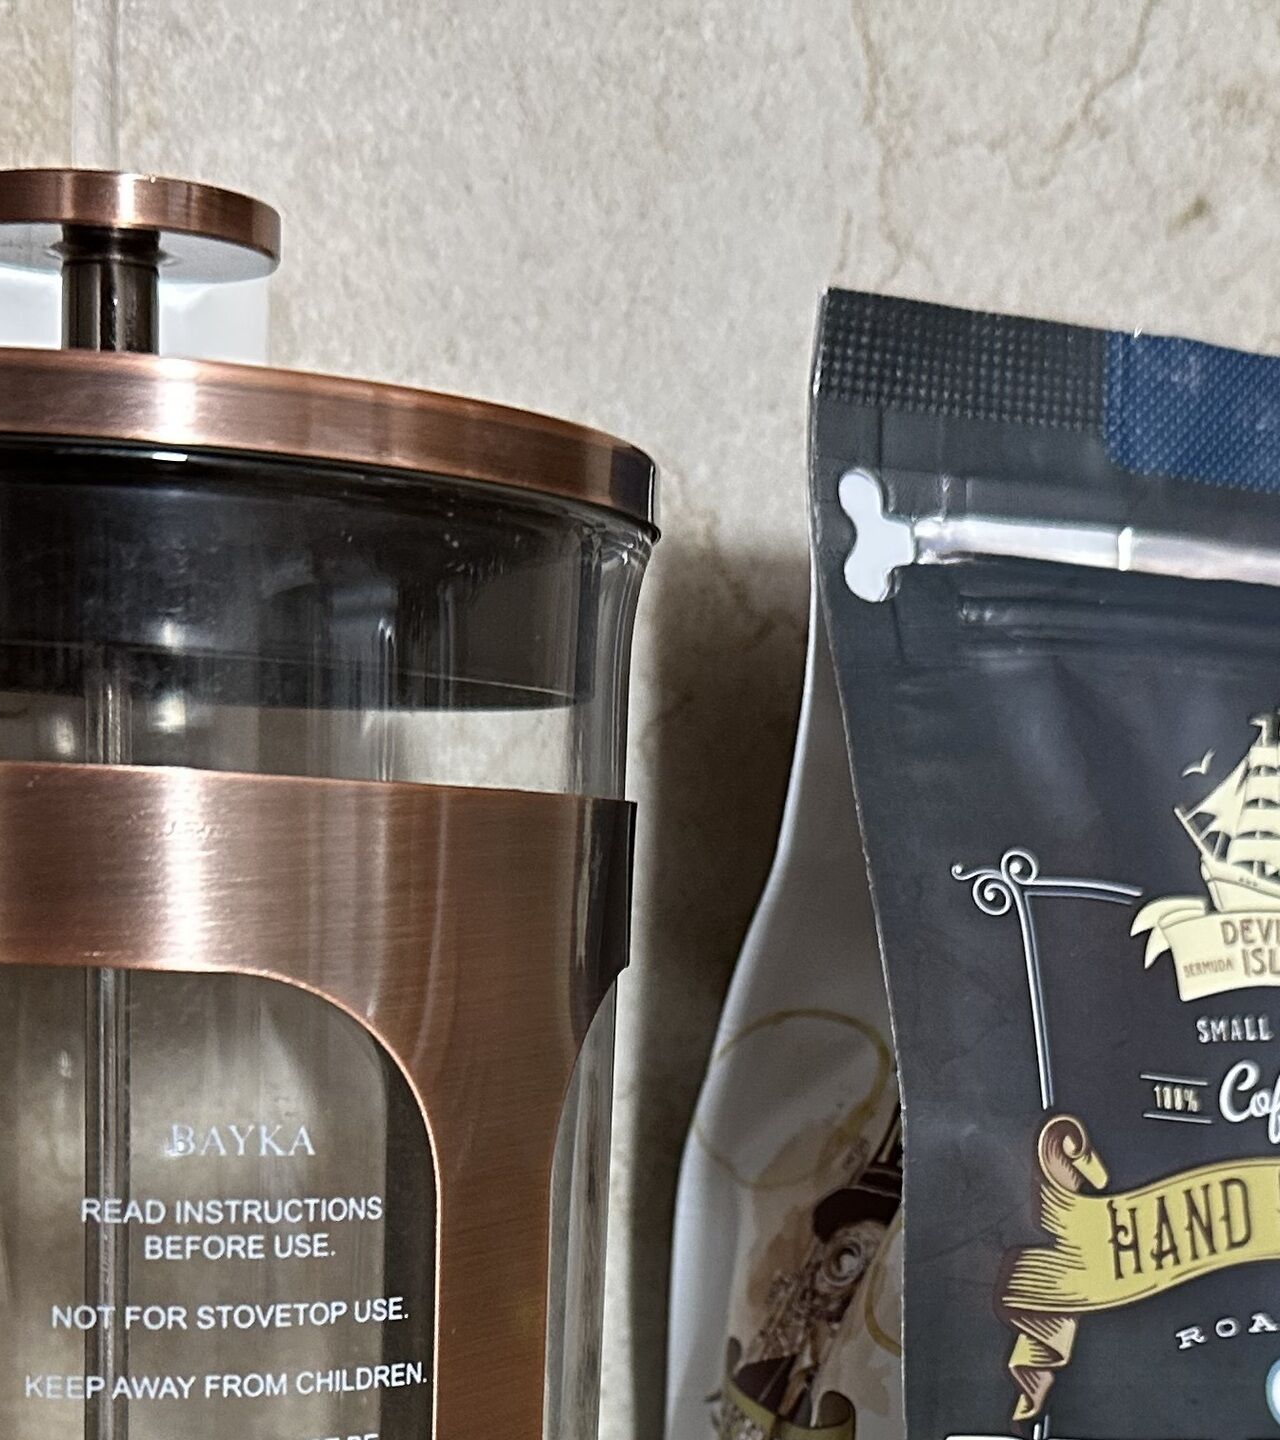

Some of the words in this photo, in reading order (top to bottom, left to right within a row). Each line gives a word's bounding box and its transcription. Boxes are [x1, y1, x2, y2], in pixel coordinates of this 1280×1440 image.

[1183, 958, 1234, 978] BERMUDA
[1196, 1014, 1273, 1044] SMALL
[167, 1123, 317, 1157] BAYKA
[80, 1198, 166, 1225] READ
[174, 1195, 384, 1224] INSTRUCTIONS
[1108, 1175, 1254, 1281] HAND
[144, 1234, 265, 1261] BEFORE
[274, 1232, 336, 1259] USE.
[51, 1304, 114, 1330] NOT
[124, 1304, 188, 1331] FOR
[196, 1300, 348, 1330] STOVETOP
[353, 1296, 410, 1322] USE.
[25, 1375, 105, 1399] KEEP
[111, 1375, 197, 1401] AWAY
[204, 1372, 288, 1398] FROM
[295, 1361, 428, 1395] CHILDREN.
